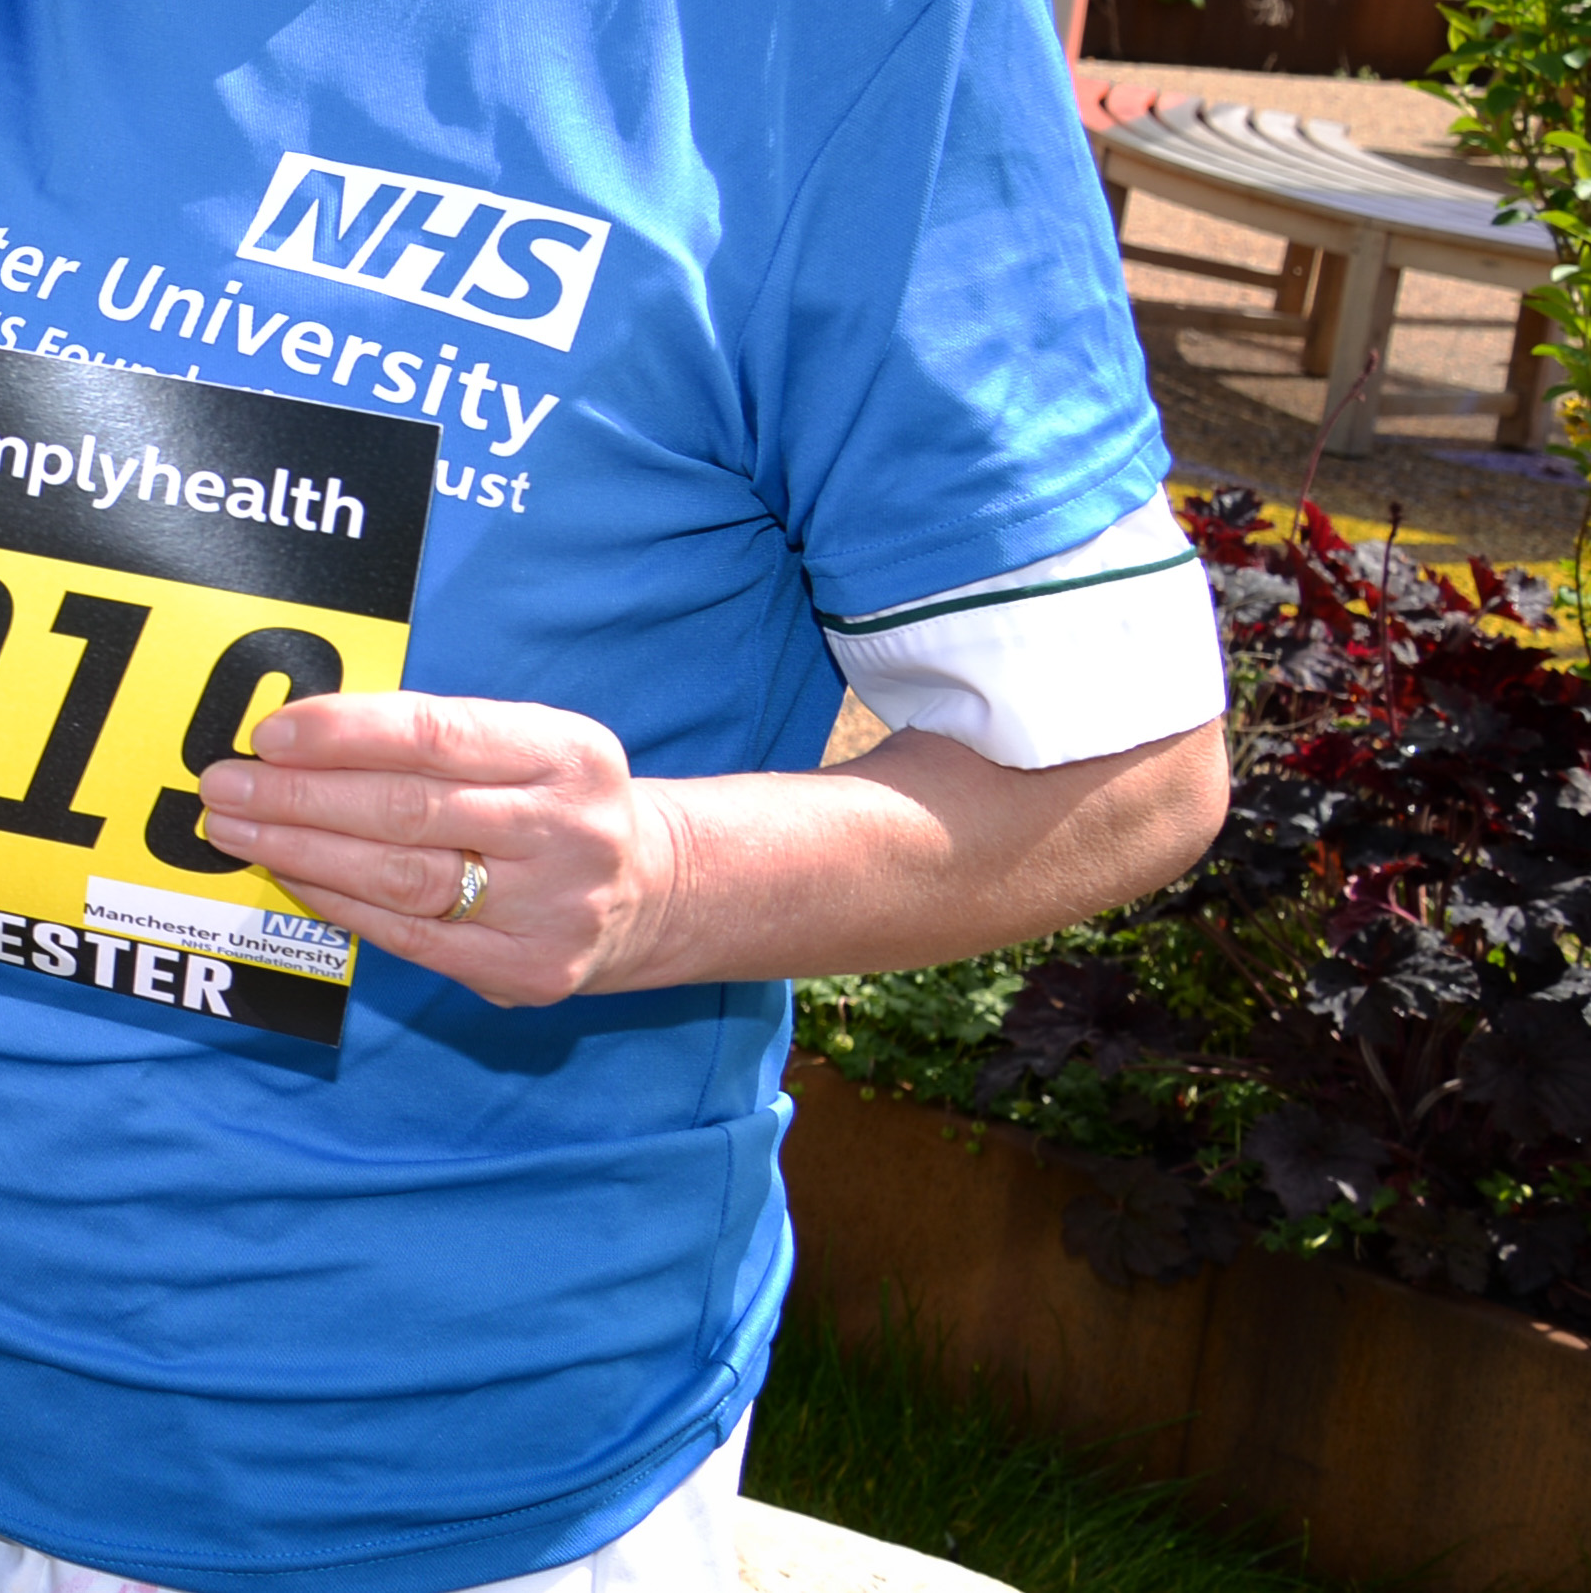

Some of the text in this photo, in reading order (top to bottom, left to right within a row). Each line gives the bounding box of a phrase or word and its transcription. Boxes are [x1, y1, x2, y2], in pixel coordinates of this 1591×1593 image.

[248, 167, 594, 322] NHS
[99, 256, 560, 458] University
[436, 459, 531, 514] ust
[83, 902, 349, 971] Manchester University
[181, 938, 345, 982] NHS Foundation Trust
[264, 912, 350, 949] NHS
